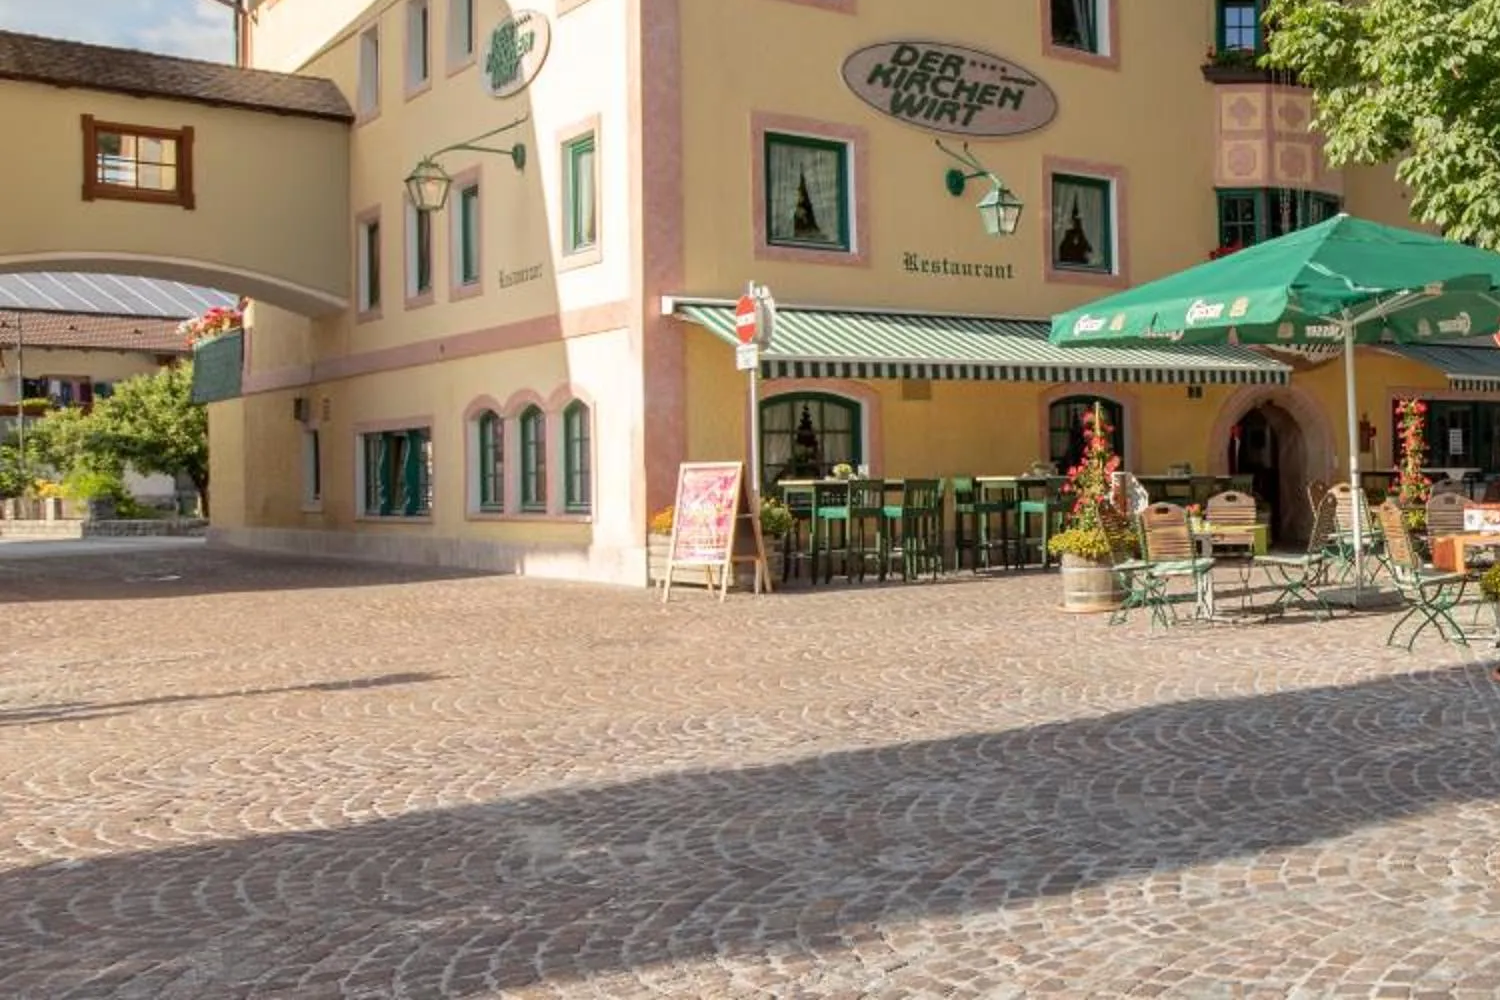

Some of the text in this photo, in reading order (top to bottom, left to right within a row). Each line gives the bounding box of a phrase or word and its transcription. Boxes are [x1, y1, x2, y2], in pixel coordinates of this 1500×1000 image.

[890, 44, 965, 77] DER
[866, 63, 1025, 111] KIRCHEN
[890, 91, 983, 127] WIRT
[903, 251, 1014, 279] Restaurant
